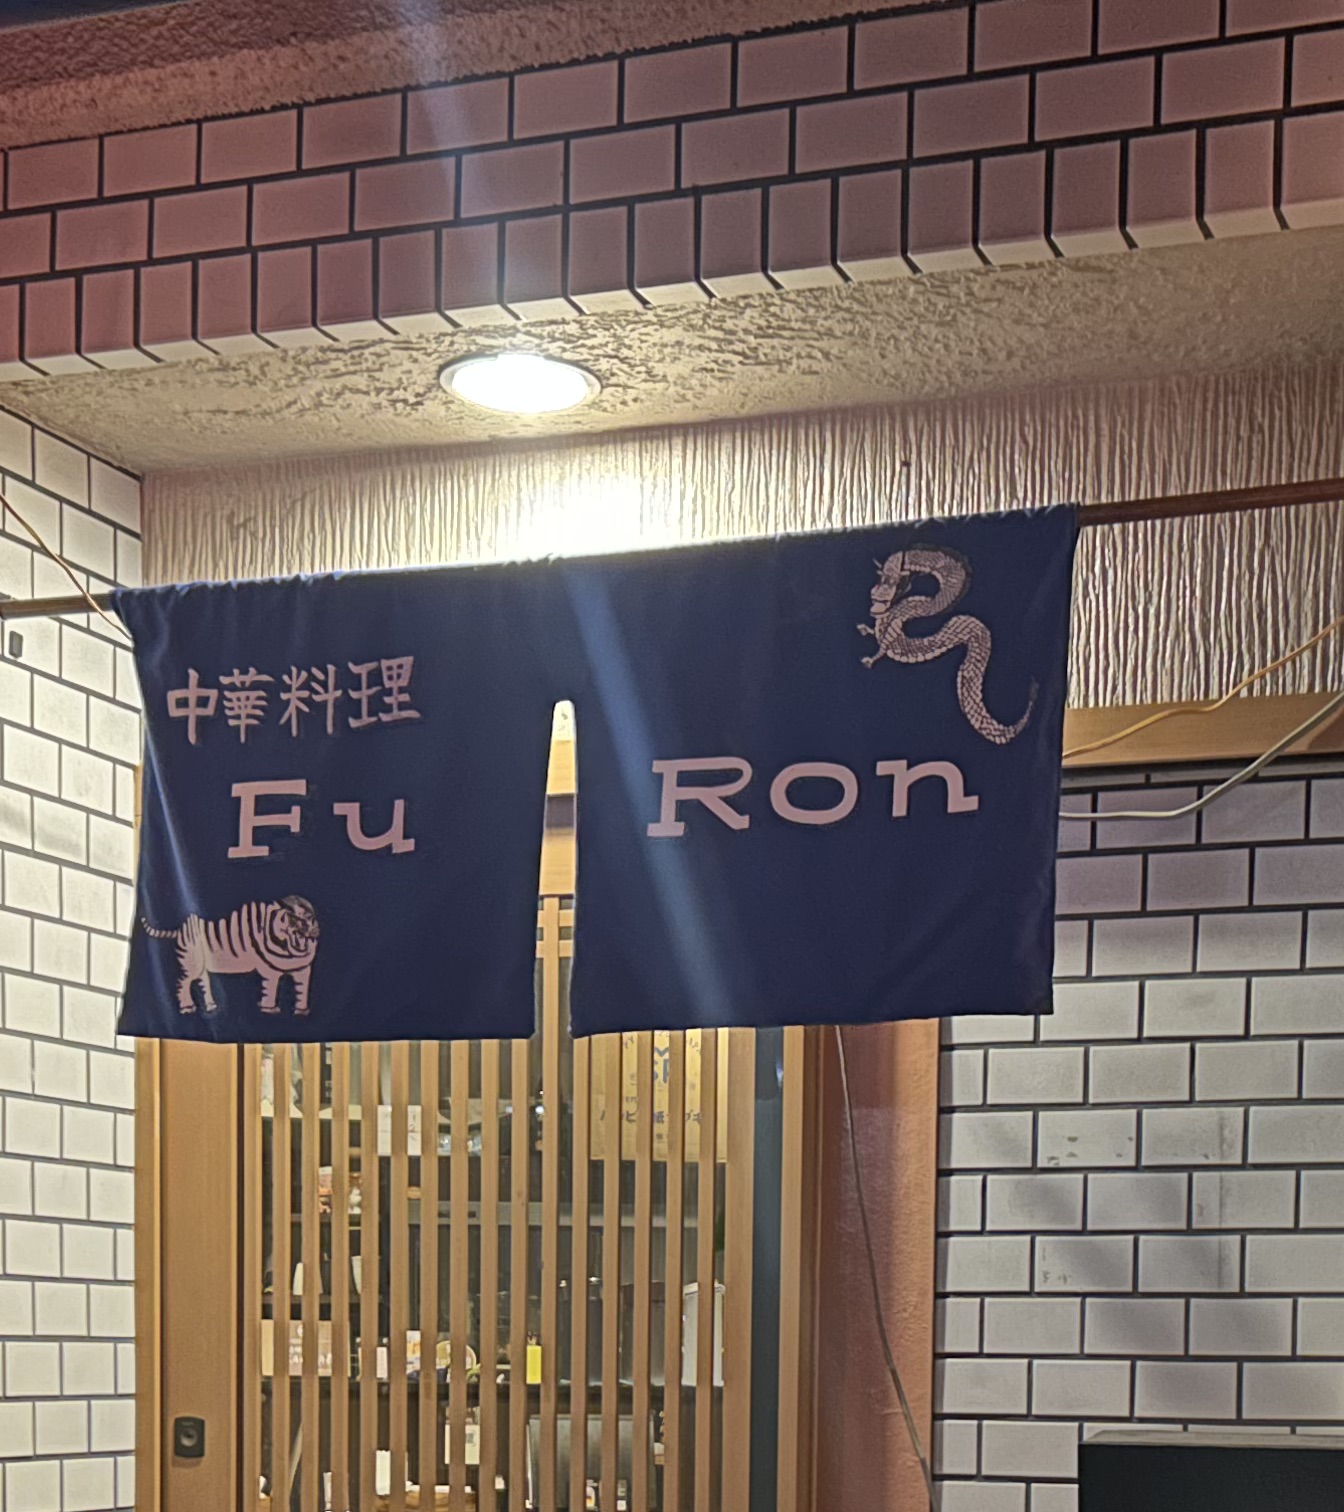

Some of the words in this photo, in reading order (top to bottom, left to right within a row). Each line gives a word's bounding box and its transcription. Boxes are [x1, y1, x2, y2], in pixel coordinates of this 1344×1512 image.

[165, 655, 422, 745] 中華料理
[228, 777, 416, 860] Fu
[645, 757, 980, 838] Ron
